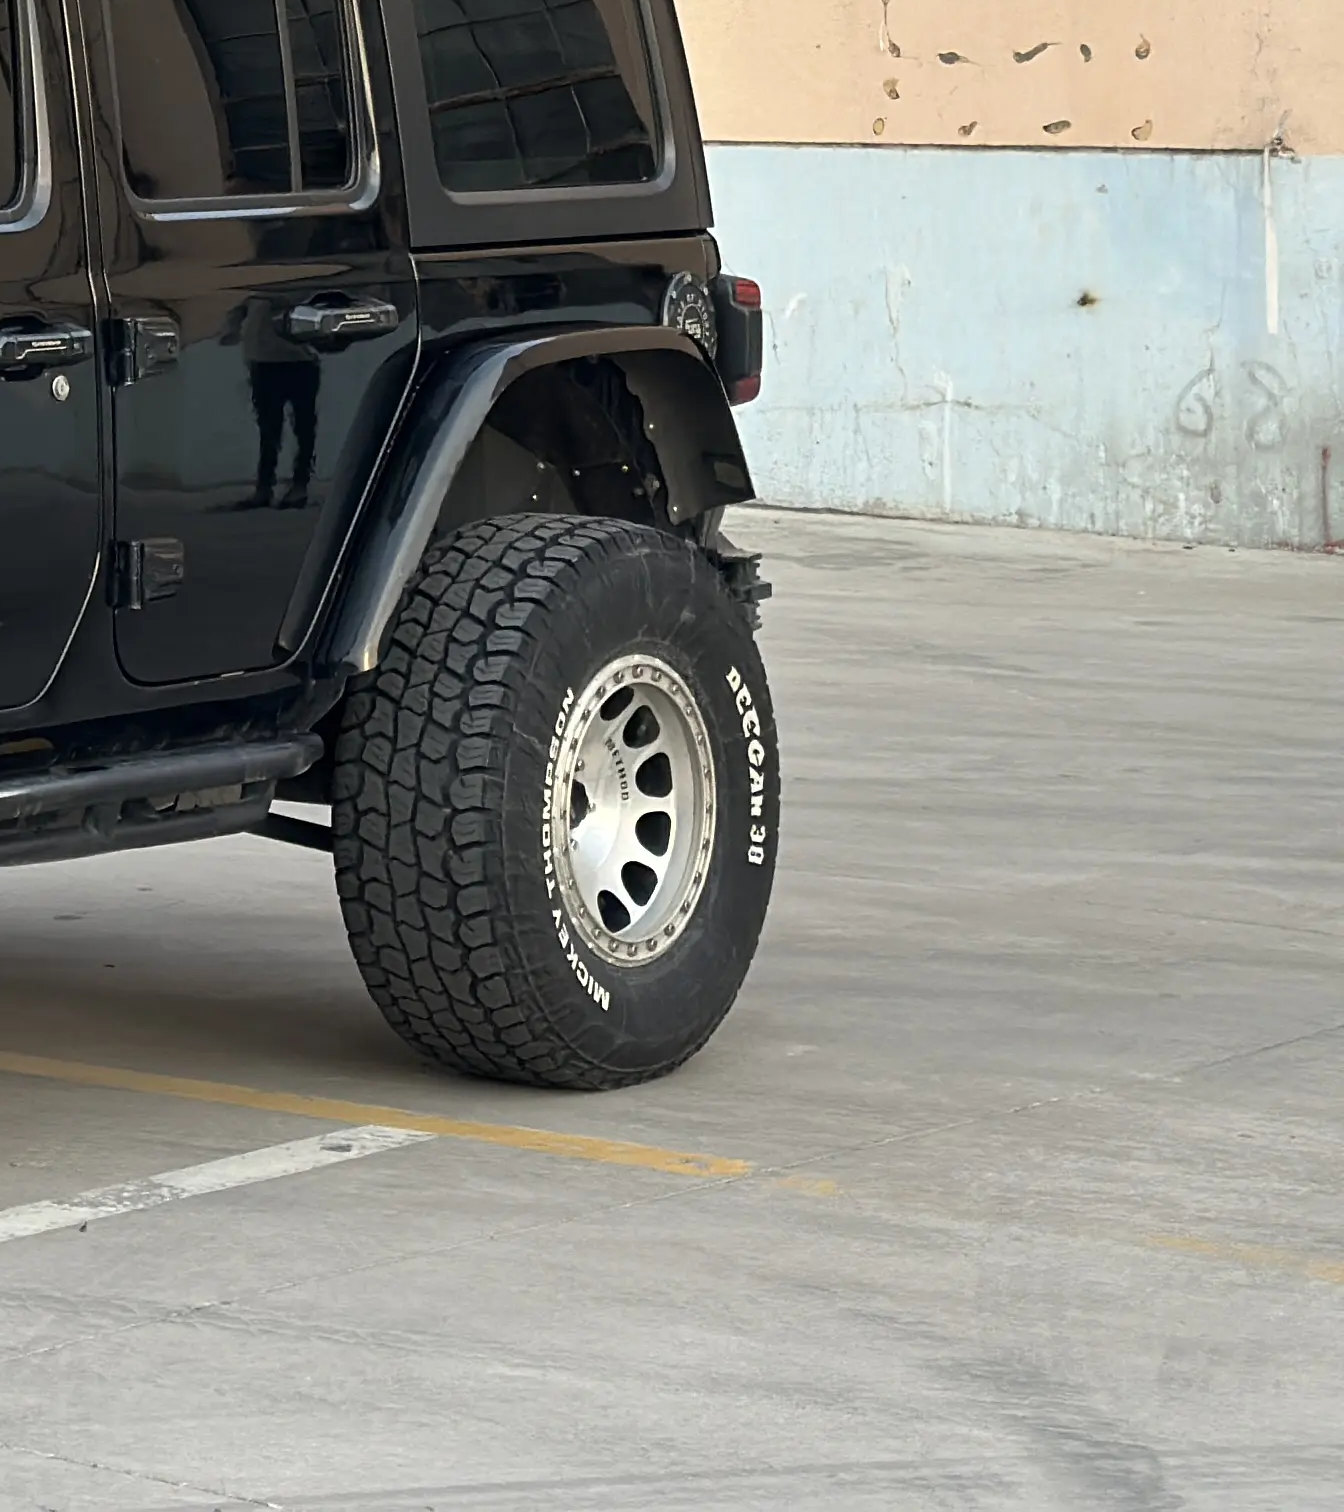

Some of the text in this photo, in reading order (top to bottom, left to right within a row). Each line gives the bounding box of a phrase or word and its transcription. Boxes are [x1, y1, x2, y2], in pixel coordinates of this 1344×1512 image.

[542, 687, 610, 1012] MICKEY THOMPSON
[725, 665, 766, 865] DEEGAN 38
